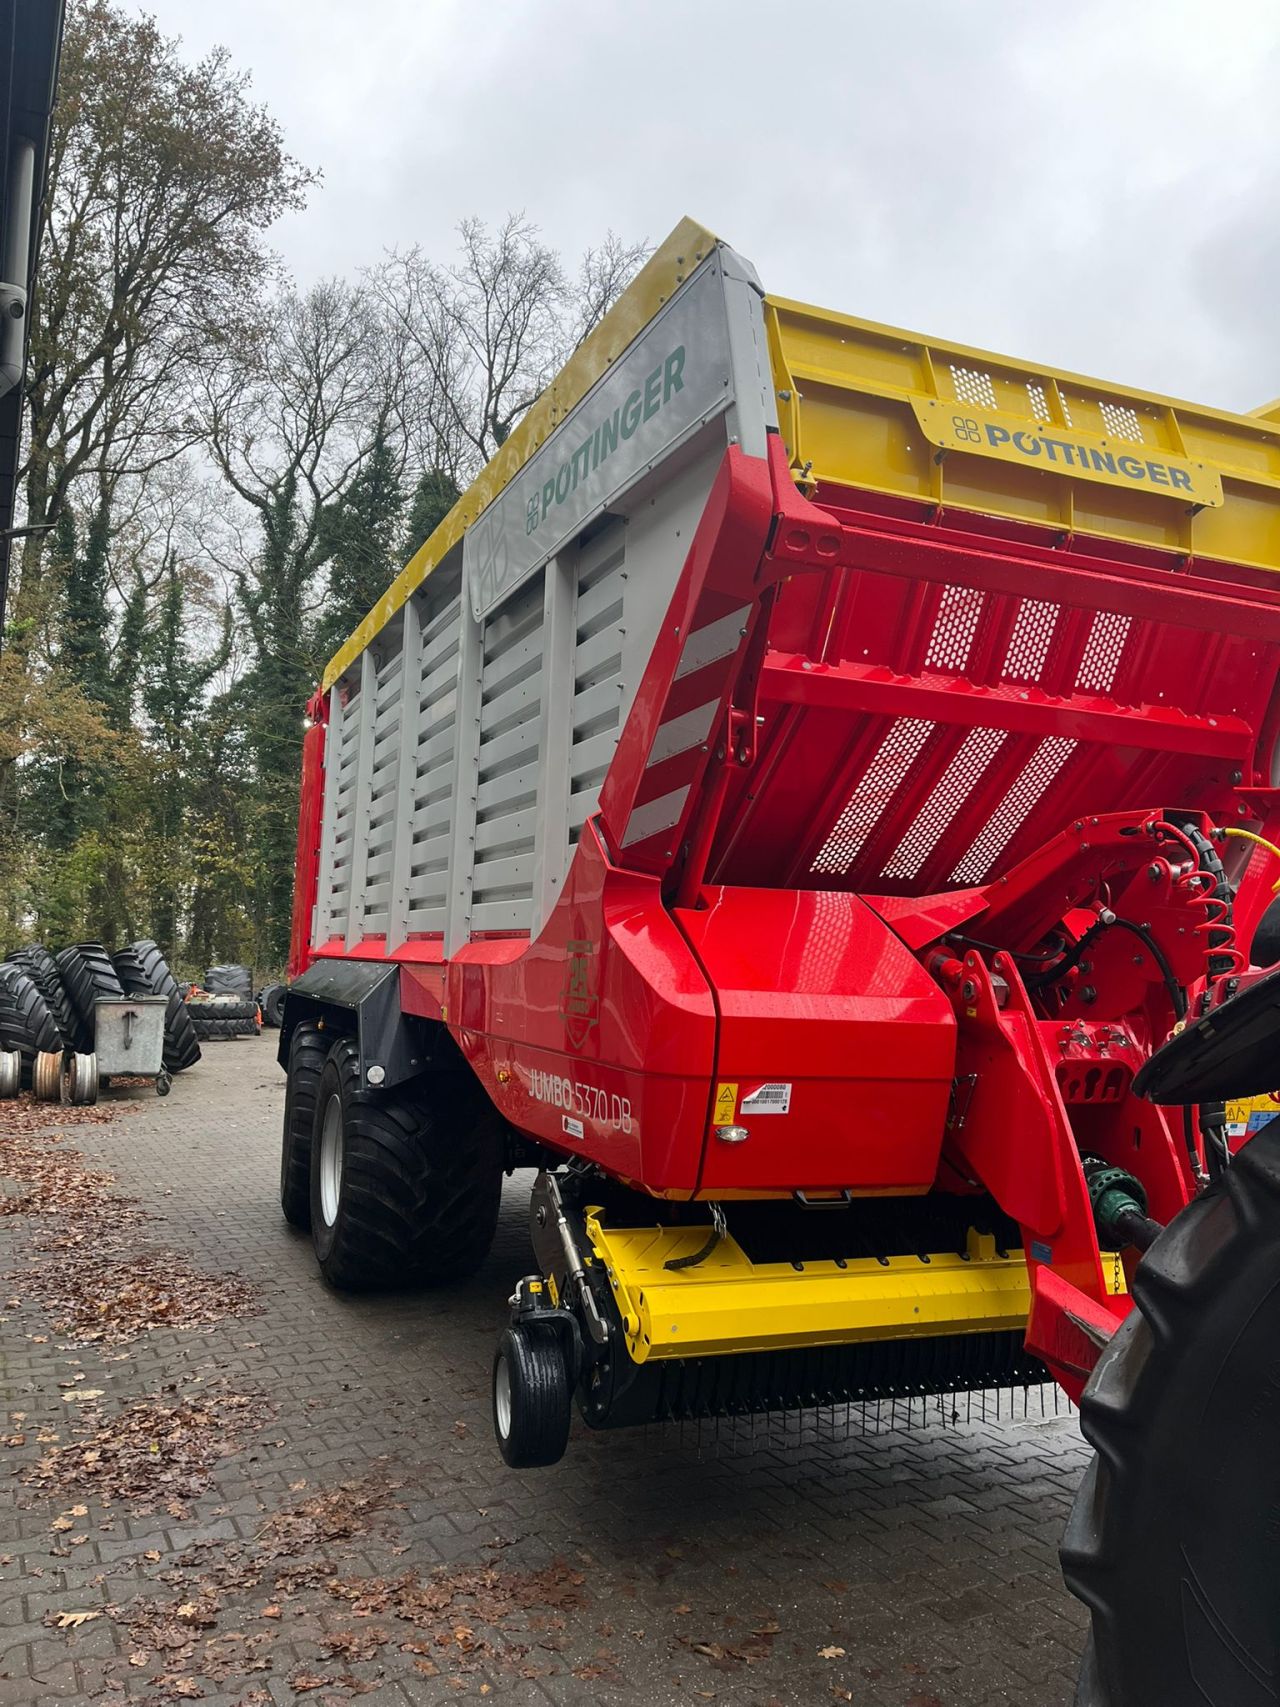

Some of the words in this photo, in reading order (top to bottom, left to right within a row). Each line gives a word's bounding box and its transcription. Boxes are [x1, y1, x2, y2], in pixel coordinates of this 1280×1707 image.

[541, 345, 685, 521] PÖTTINGER
[985, 423, 1194, 492] PÖTTINGER
[529, 1069, 572, 1110] JUMBO
[575, 1082, 607, 1124] 5370
[612, 1093, 632, 1134] DB
